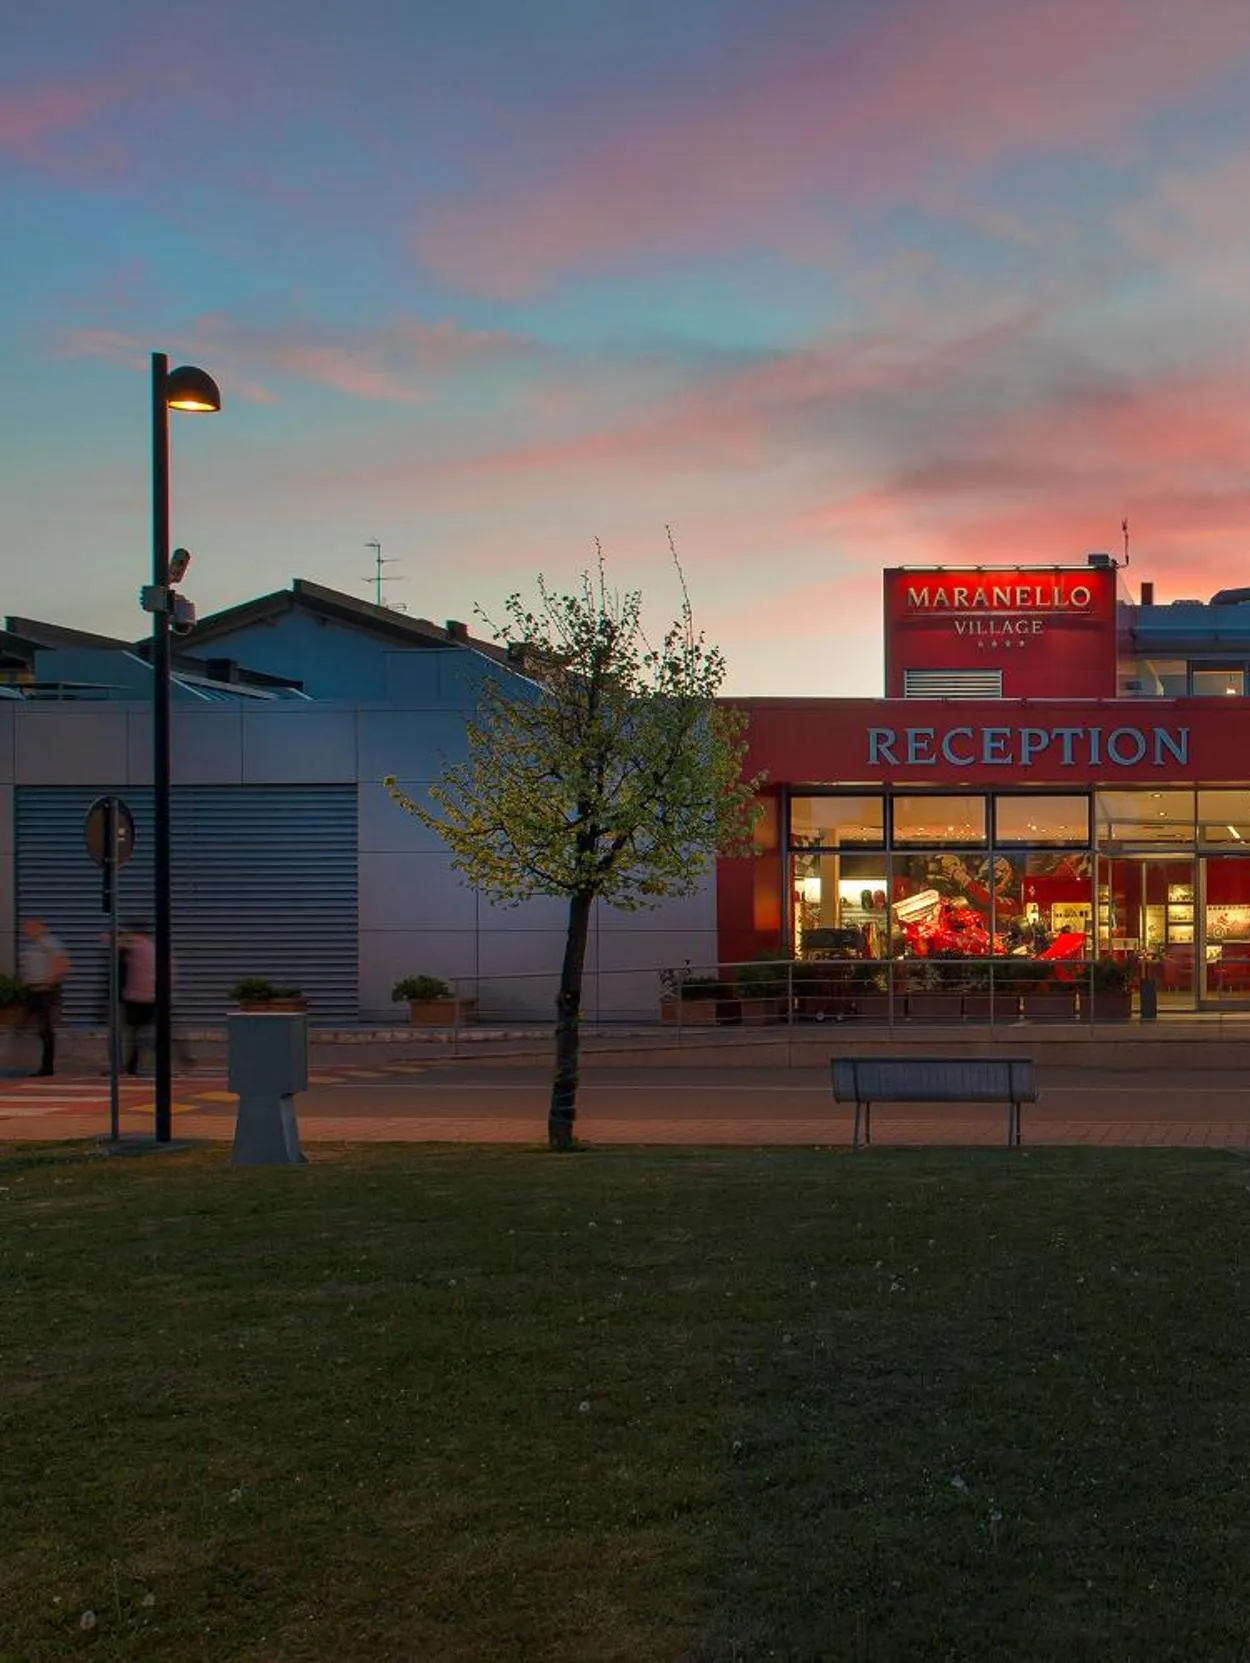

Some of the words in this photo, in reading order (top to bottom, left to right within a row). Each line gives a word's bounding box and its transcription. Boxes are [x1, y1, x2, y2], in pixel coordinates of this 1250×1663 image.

[907, 585, 1092, 608] MARANELLO
[954, 619, 1044, 635] VILLAGE
[865, 727, 1190, 766] RECEPTION
